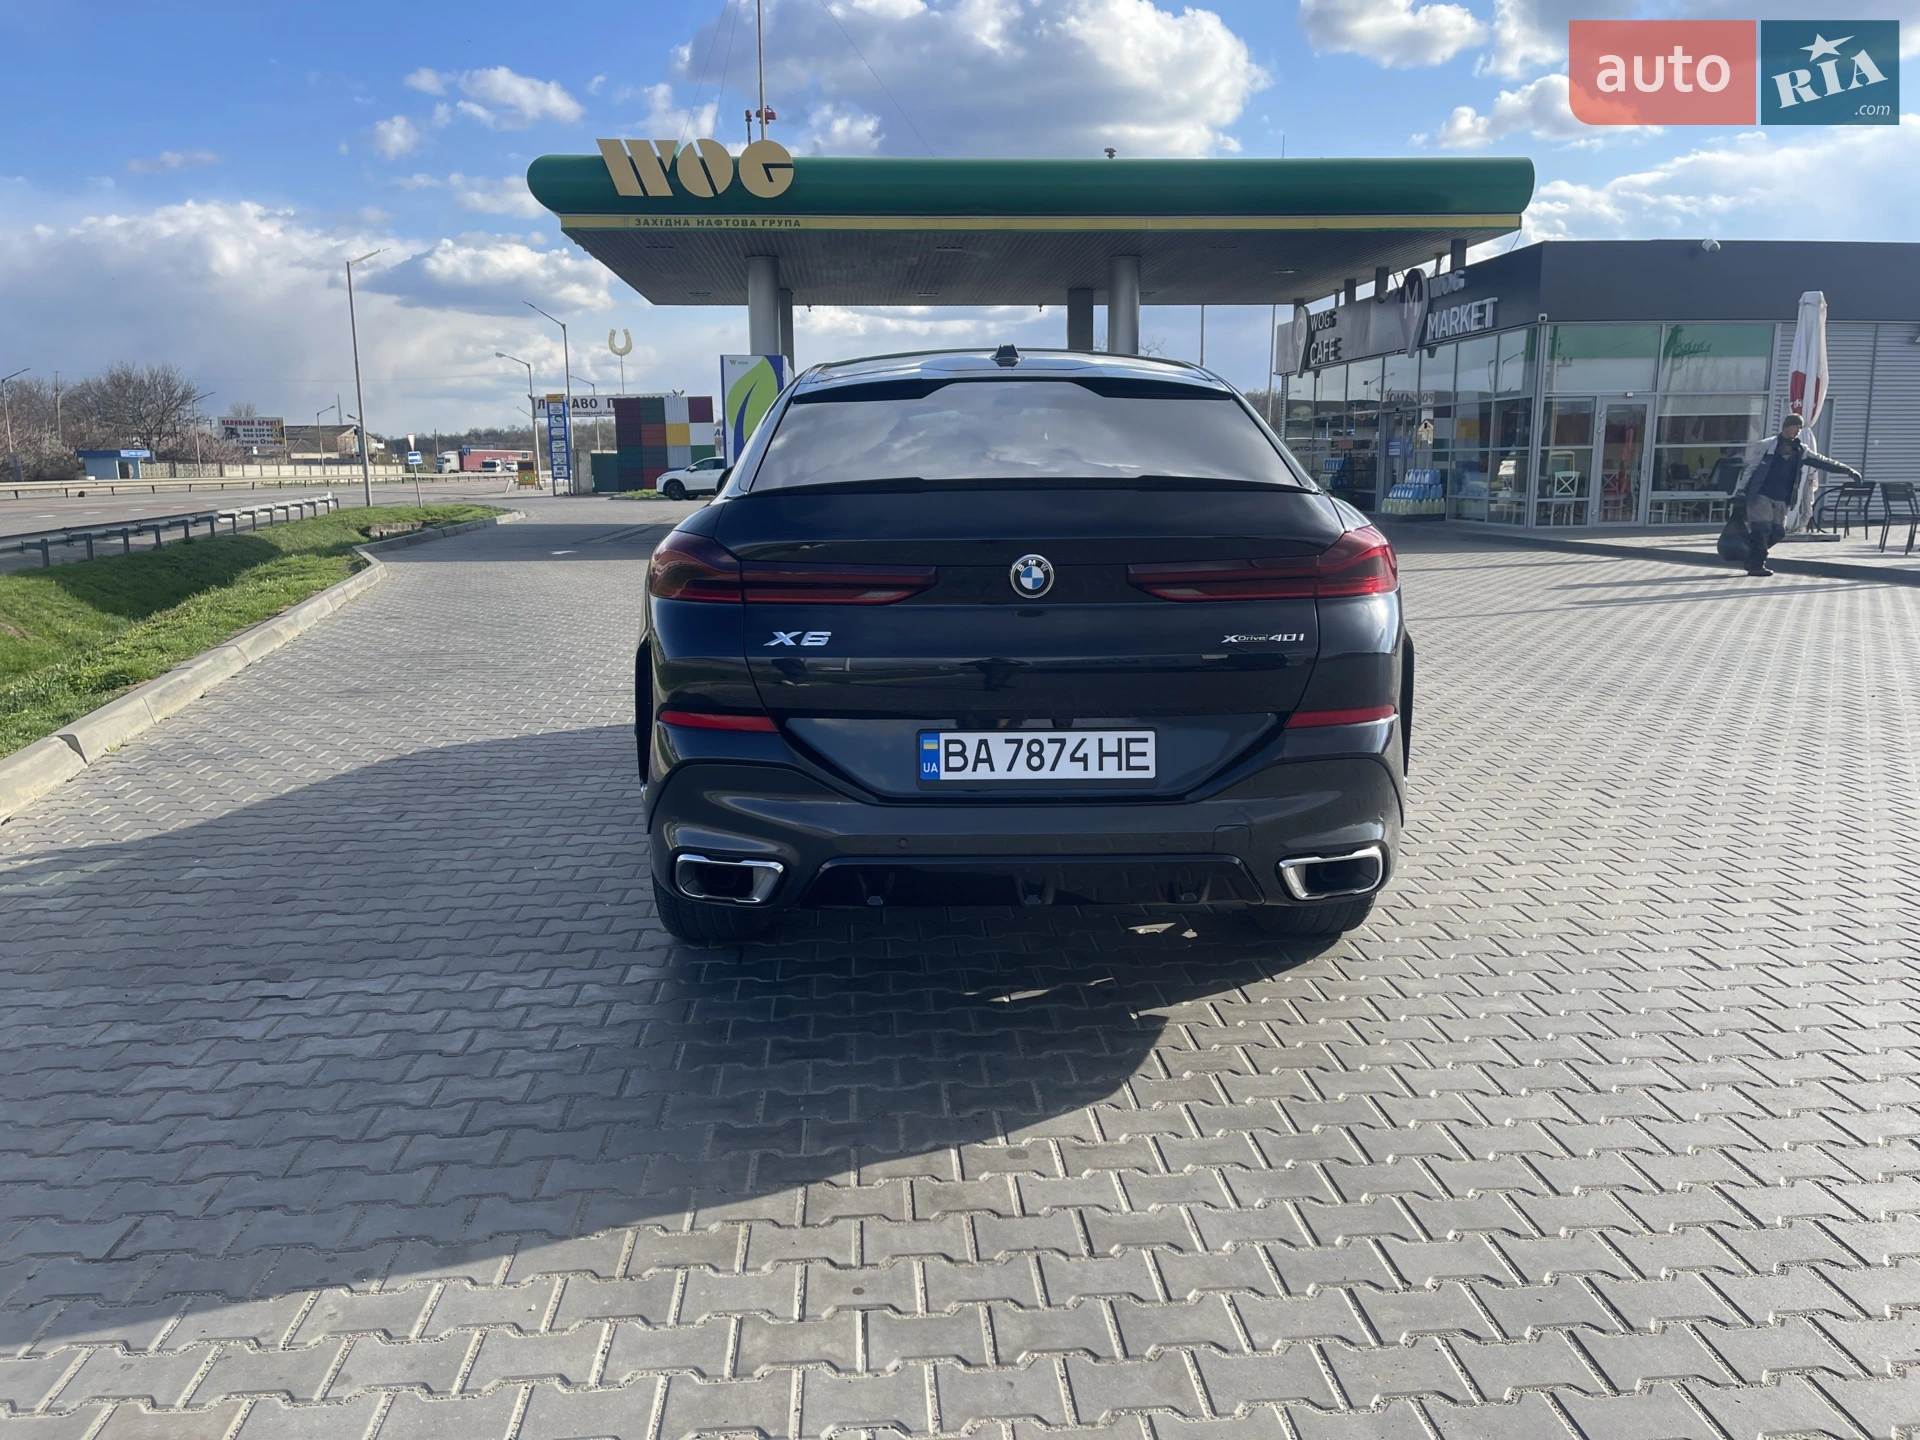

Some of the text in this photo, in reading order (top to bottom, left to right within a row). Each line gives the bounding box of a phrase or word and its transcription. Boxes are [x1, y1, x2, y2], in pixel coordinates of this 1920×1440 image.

[596, 138, 794, 198] WOG
[634, 218, 801, 228] ЗАХІДНА НАФТОВА ГРУПА
[1429, 270, 1465, 298] WOG
[1310, 311, 1336, 331] WOG
[1426, 297, 1498, 340] MARKET
[1309, 338, 1341, 364] CAFE
[1016, 559, 1049, 572] BMW
[763, 631, 832, 646] X6
[944, 737, 1150, 772] BA 7874 HE
[923, 762, 938, 773] UA
